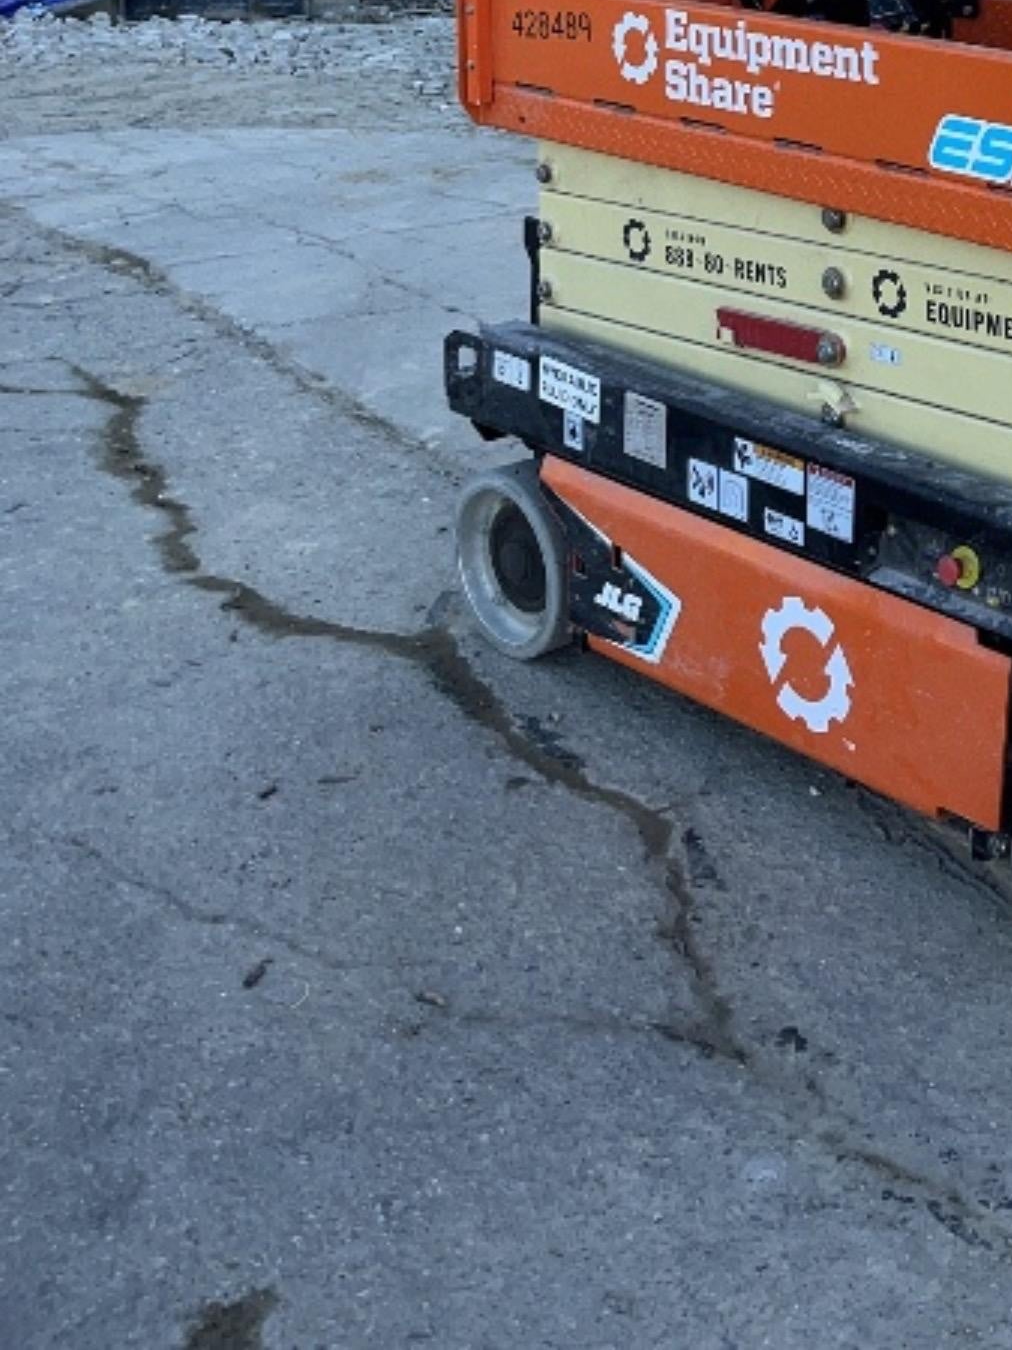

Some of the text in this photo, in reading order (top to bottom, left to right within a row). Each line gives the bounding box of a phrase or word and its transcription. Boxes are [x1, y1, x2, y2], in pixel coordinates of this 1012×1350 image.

[511, 9, 593, 43] 428489
[665, 8, 880, 85] Equipment
[665, 58, 775, 118] Share
[593, 581, 644, 622] JLG
